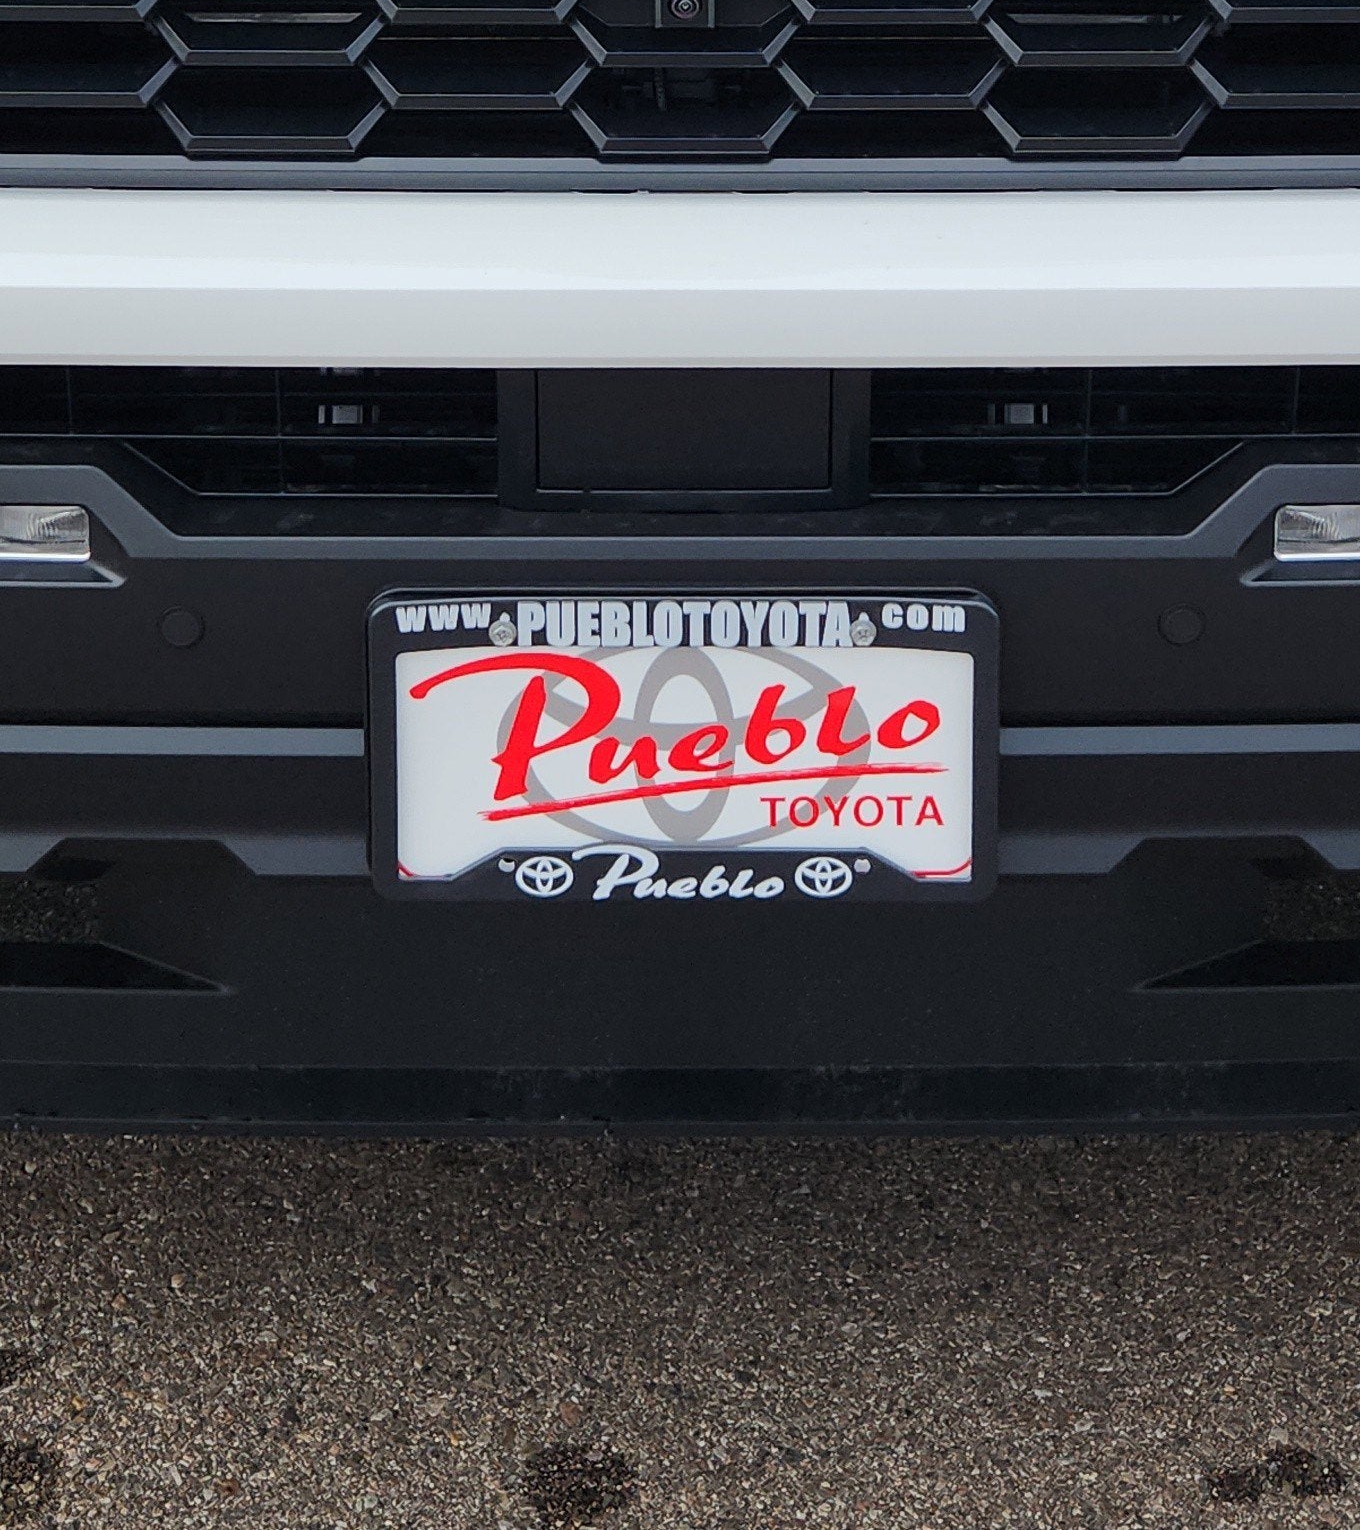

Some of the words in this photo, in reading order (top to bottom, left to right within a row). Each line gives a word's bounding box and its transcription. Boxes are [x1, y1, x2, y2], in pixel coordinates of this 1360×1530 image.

[409, 652, 941, 802] Pueblo
[760, 795, 944, 827] TOYOTA
[571, 843, 785, 900] Pueblo
